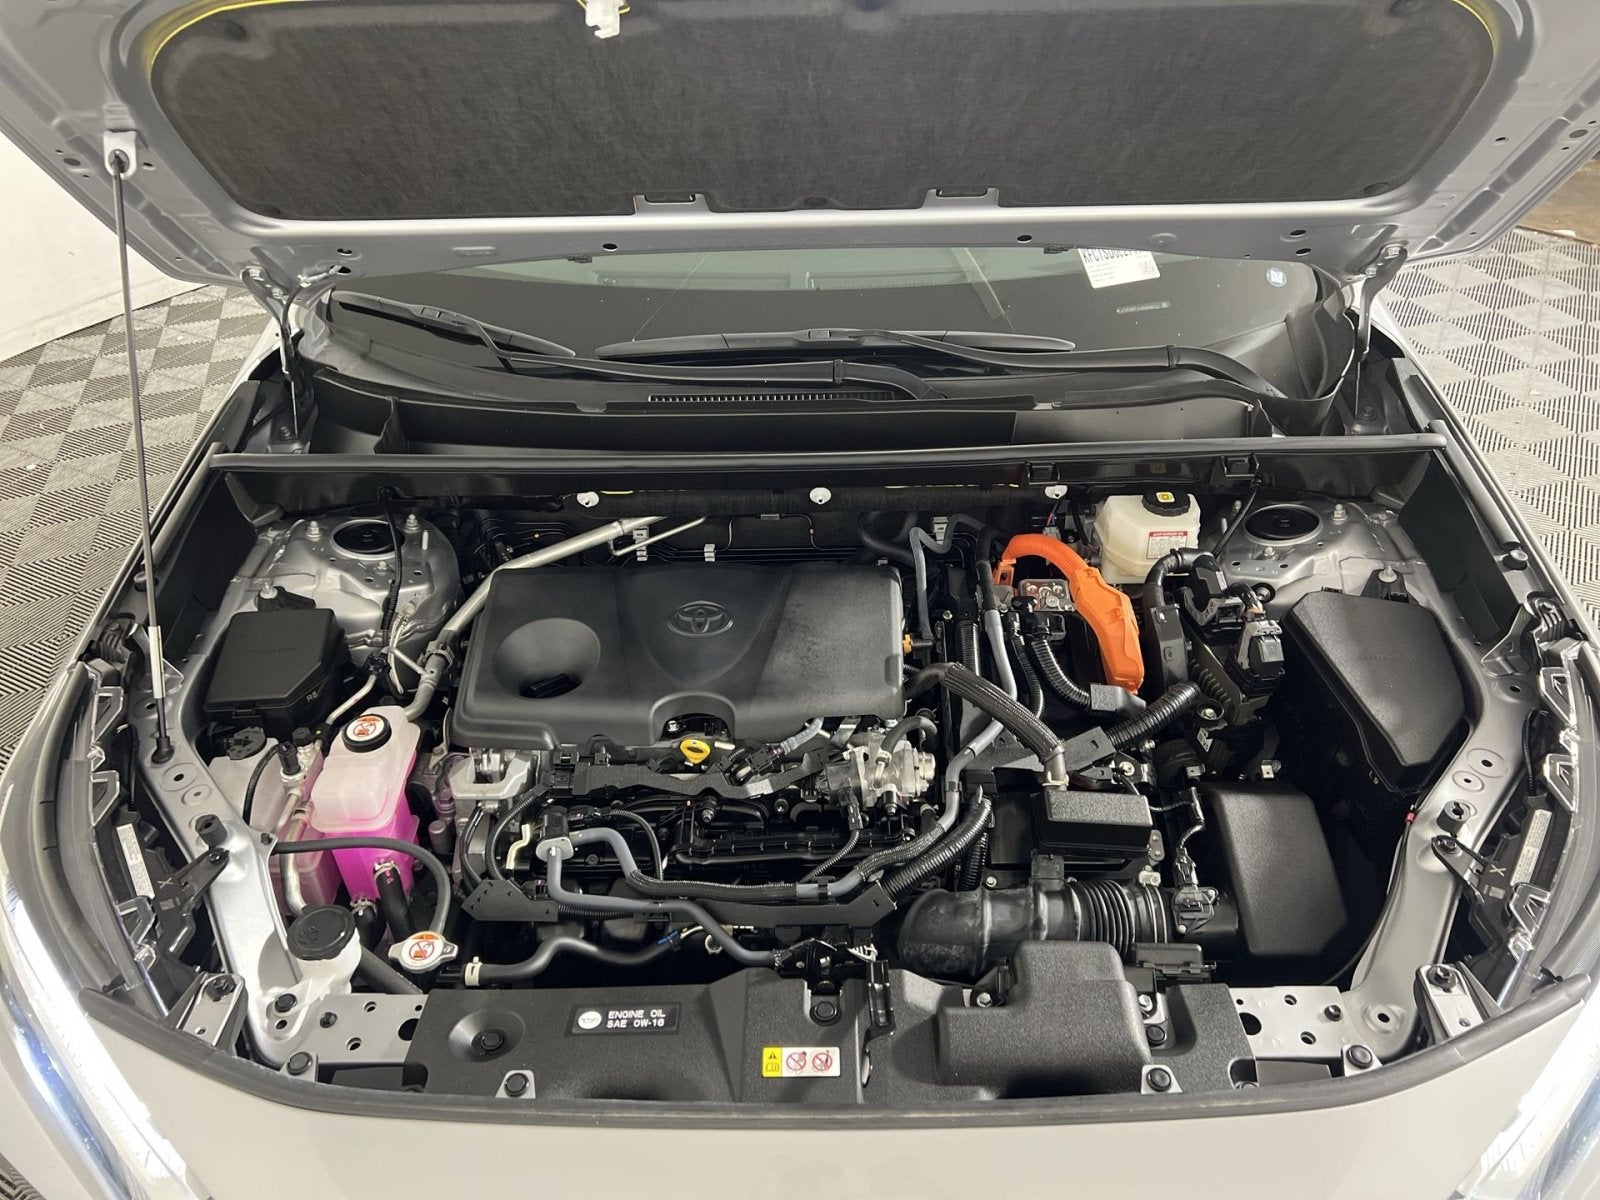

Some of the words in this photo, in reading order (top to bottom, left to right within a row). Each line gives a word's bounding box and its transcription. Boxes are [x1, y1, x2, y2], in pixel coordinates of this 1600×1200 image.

[608, 1009, 645, 1019] ENGINE
[650, 1009, 666, 1018] OIL
[606, 1019, 627, 1028] SAE
